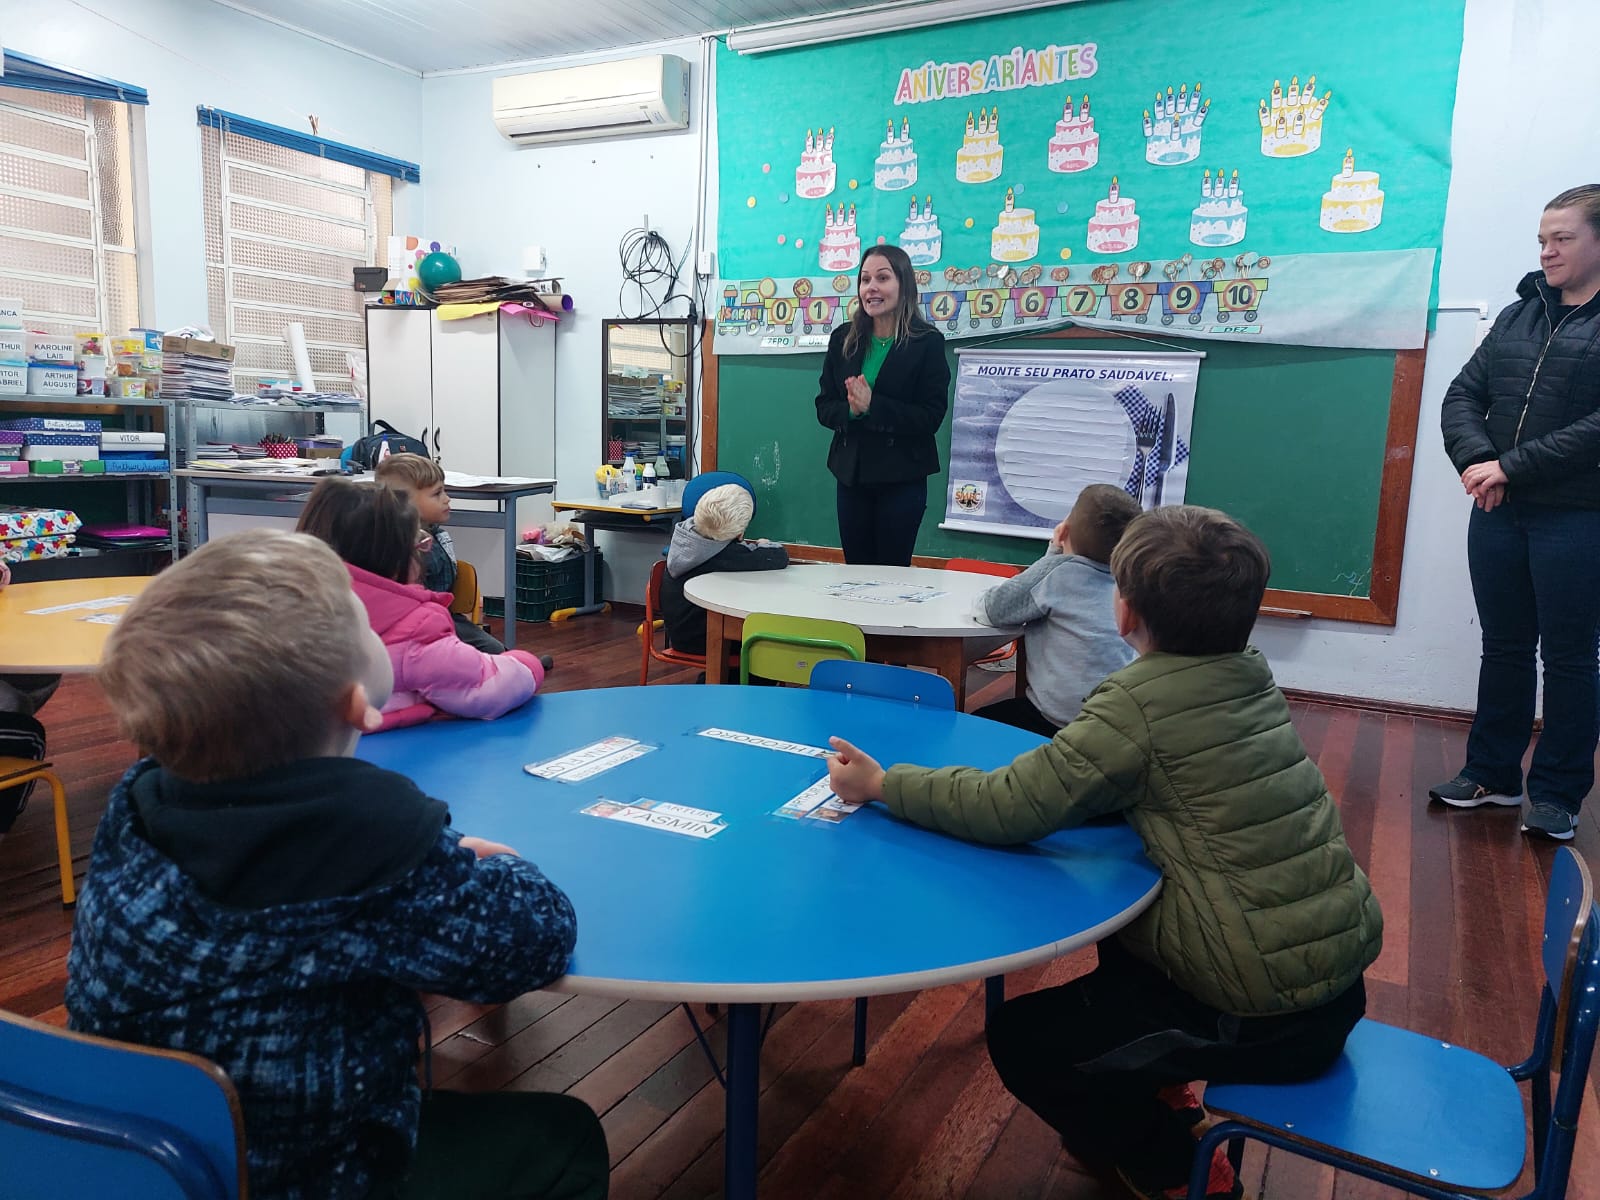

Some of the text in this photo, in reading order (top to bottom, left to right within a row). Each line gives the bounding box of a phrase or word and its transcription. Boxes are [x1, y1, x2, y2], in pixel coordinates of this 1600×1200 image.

[896, 46, 1096, 101] ANIVERSARIANTES
[724, 307, 763, 321] SAFARI
[776, 285, 1251, 320] 0 1 4 5 6 7 8 9 10
[34, 343, 73, 351] KAROLINE
[977, 365, 1174, 382] MONTE SEU PRATO SAUDÁVEL:
[706, 730, 816, 754] THEODORO
[622, 809, 717, 834] YASMIN
